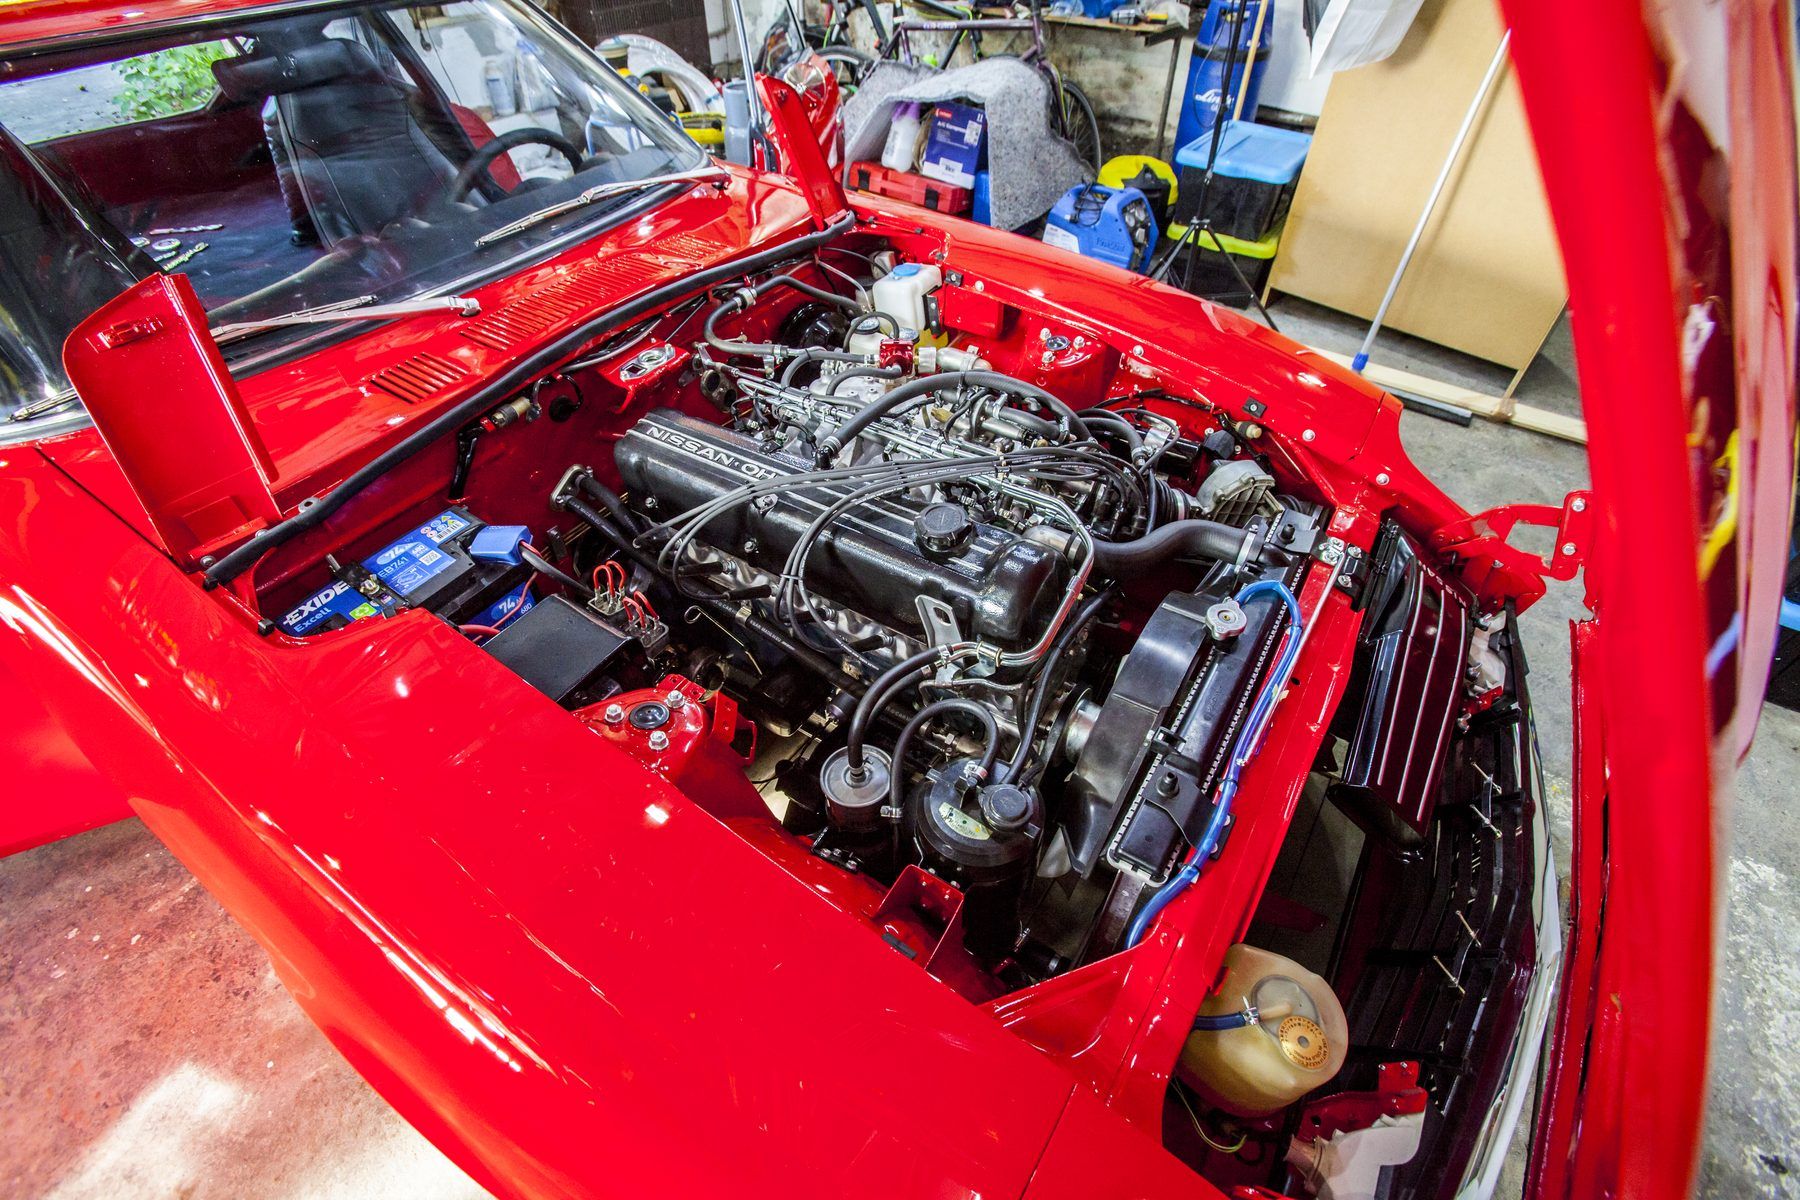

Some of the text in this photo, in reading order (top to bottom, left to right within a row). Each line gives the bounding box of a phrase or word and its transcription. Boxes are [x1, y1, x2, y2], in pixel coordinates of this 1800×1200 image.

[646, 426, 777, 480] NISSAN OH
[377, 556, 409, 578] EB741
[283, 580, 351, 626] EXIDE
[293, 607, 332, 633] Excell
